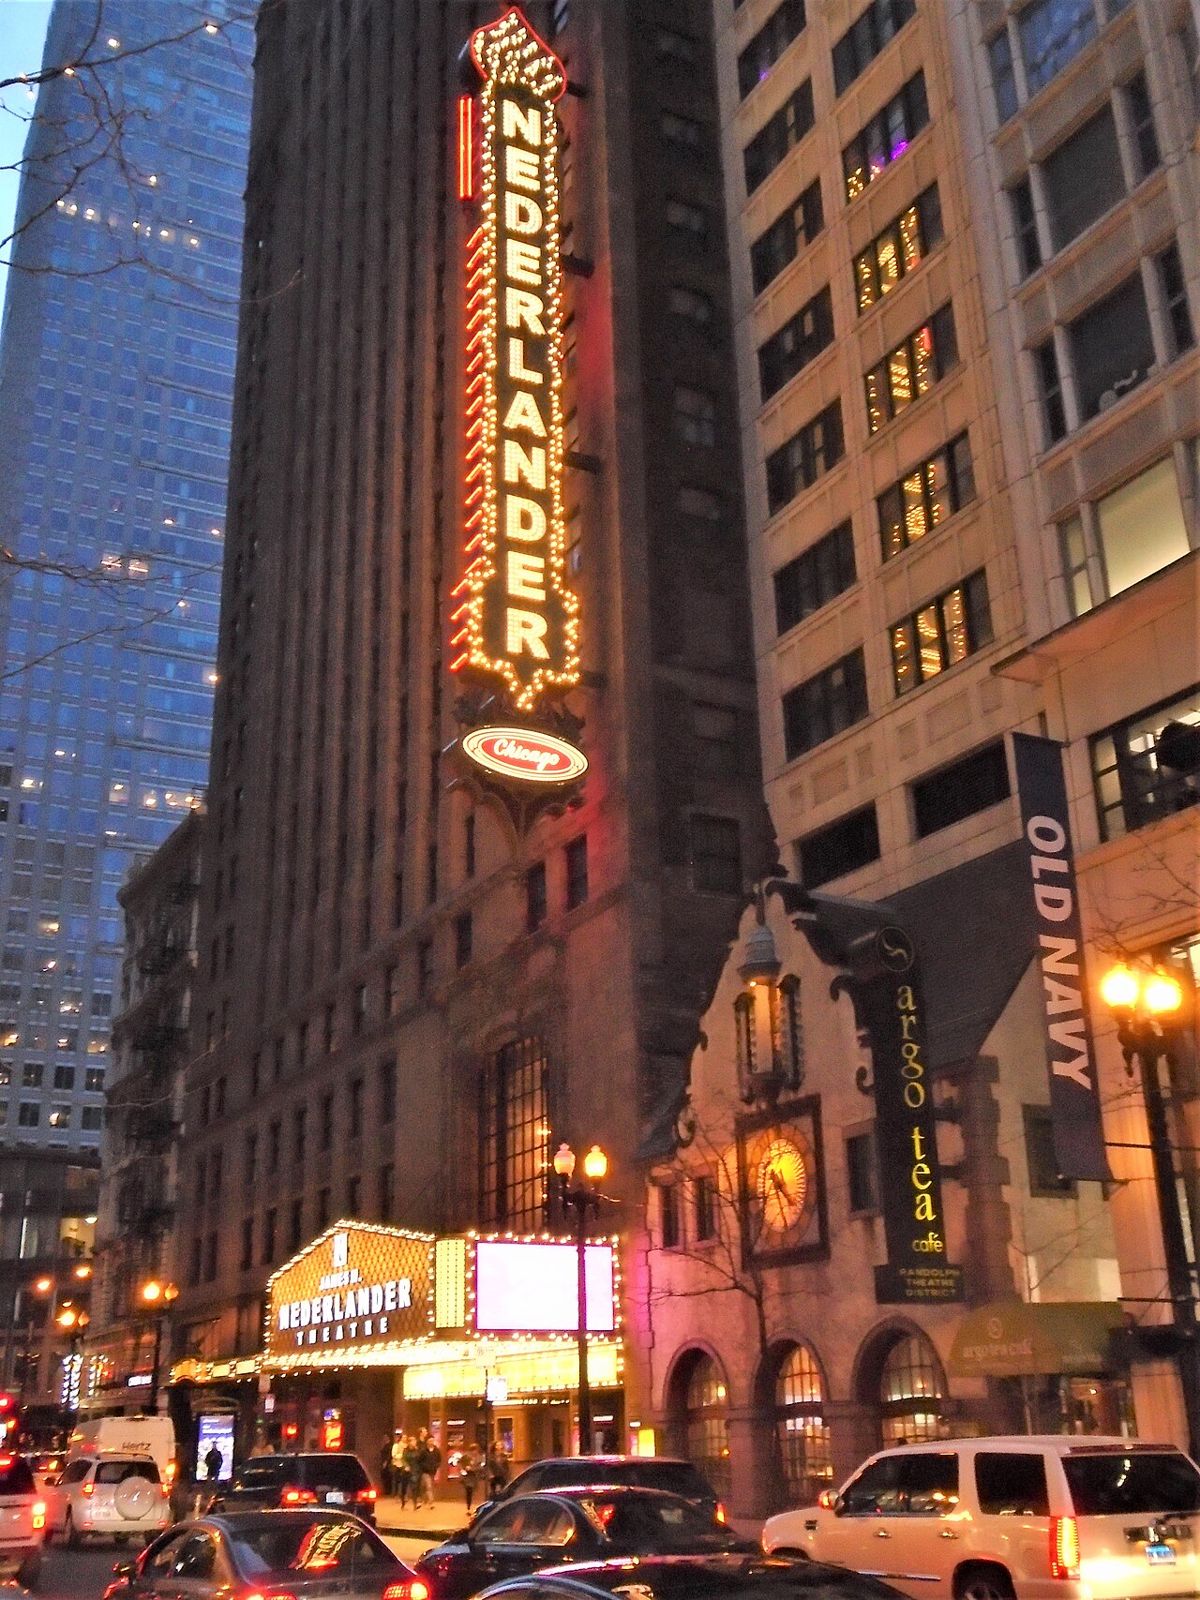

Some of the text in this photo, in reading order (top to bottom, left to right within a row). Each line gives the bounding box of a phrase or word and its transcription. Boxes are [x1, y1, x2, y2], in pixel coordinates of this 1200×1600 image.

[502, 99, 550, 660] NEDERLANDER
[493, 738, 560, 771] Chicago
[1027, 815, 1092, 1090] OLD NAVY
[897, 984, 936, 1222] argo tea
[912, 1232, 944, 1253] café
[279, 1278, 412, 1331] NEDERLANDER
[296, 1316, 388, 1346] THEATRE
